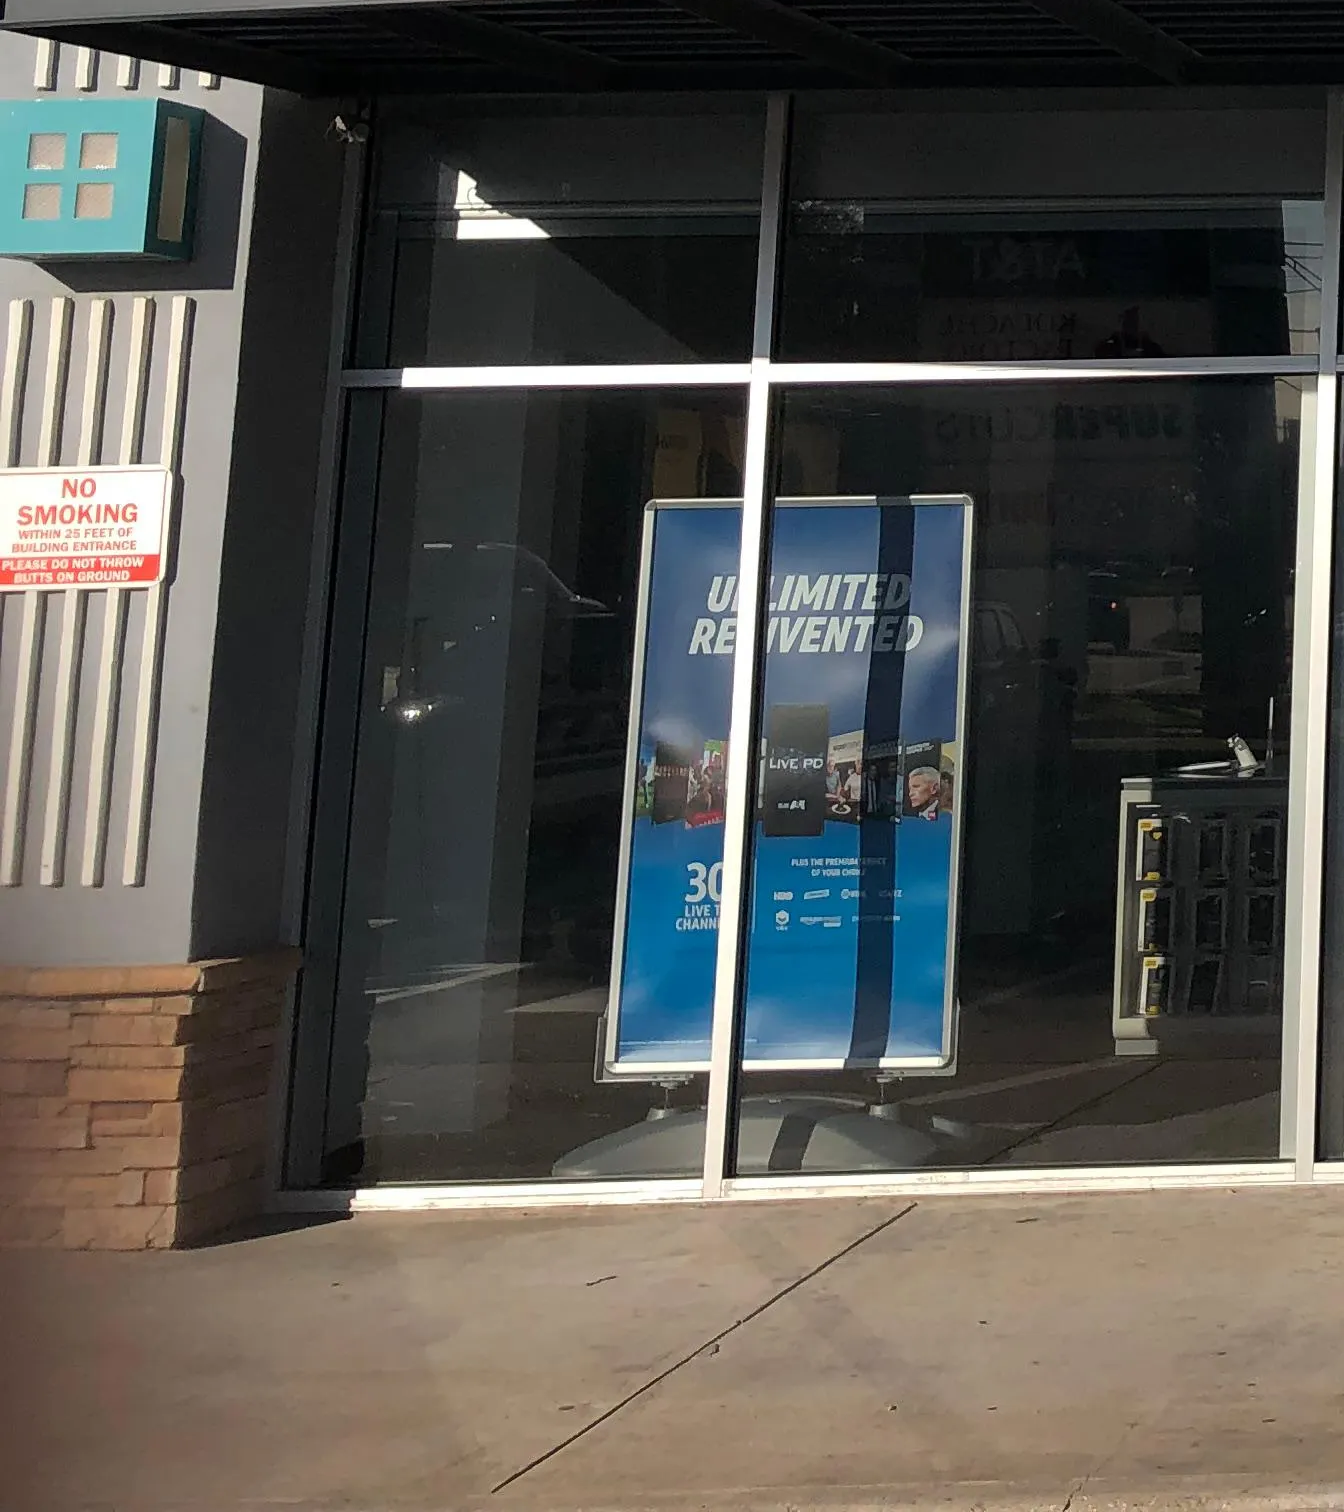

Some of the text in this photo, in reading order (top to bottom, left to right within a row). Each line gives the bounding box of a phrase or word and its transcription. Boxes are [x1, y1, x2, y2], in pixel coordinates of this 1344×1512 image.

[61, 477, 97, 499] NO
[16, 502, 138, 526] SMOKING
[18, 527, 134, 540] WITHIN 25 FEET OF
[11, 540, 137, 553] BUILDING ENTRANCE
[2, 556, 145, 570] PLEASE DO NOT THROW
[13, 571, 130, 584] BUTTS ON GROUND
[706, 573, 913, 613] ULIMITED
[688, 614, 924, 655] REVENTED
[769, 757, 824, 770] LIVE PD
[810, 857, 824, 866] THE
[684, 904, 711, 917] LIVE
[675, 917, 721, 931] CHANN
